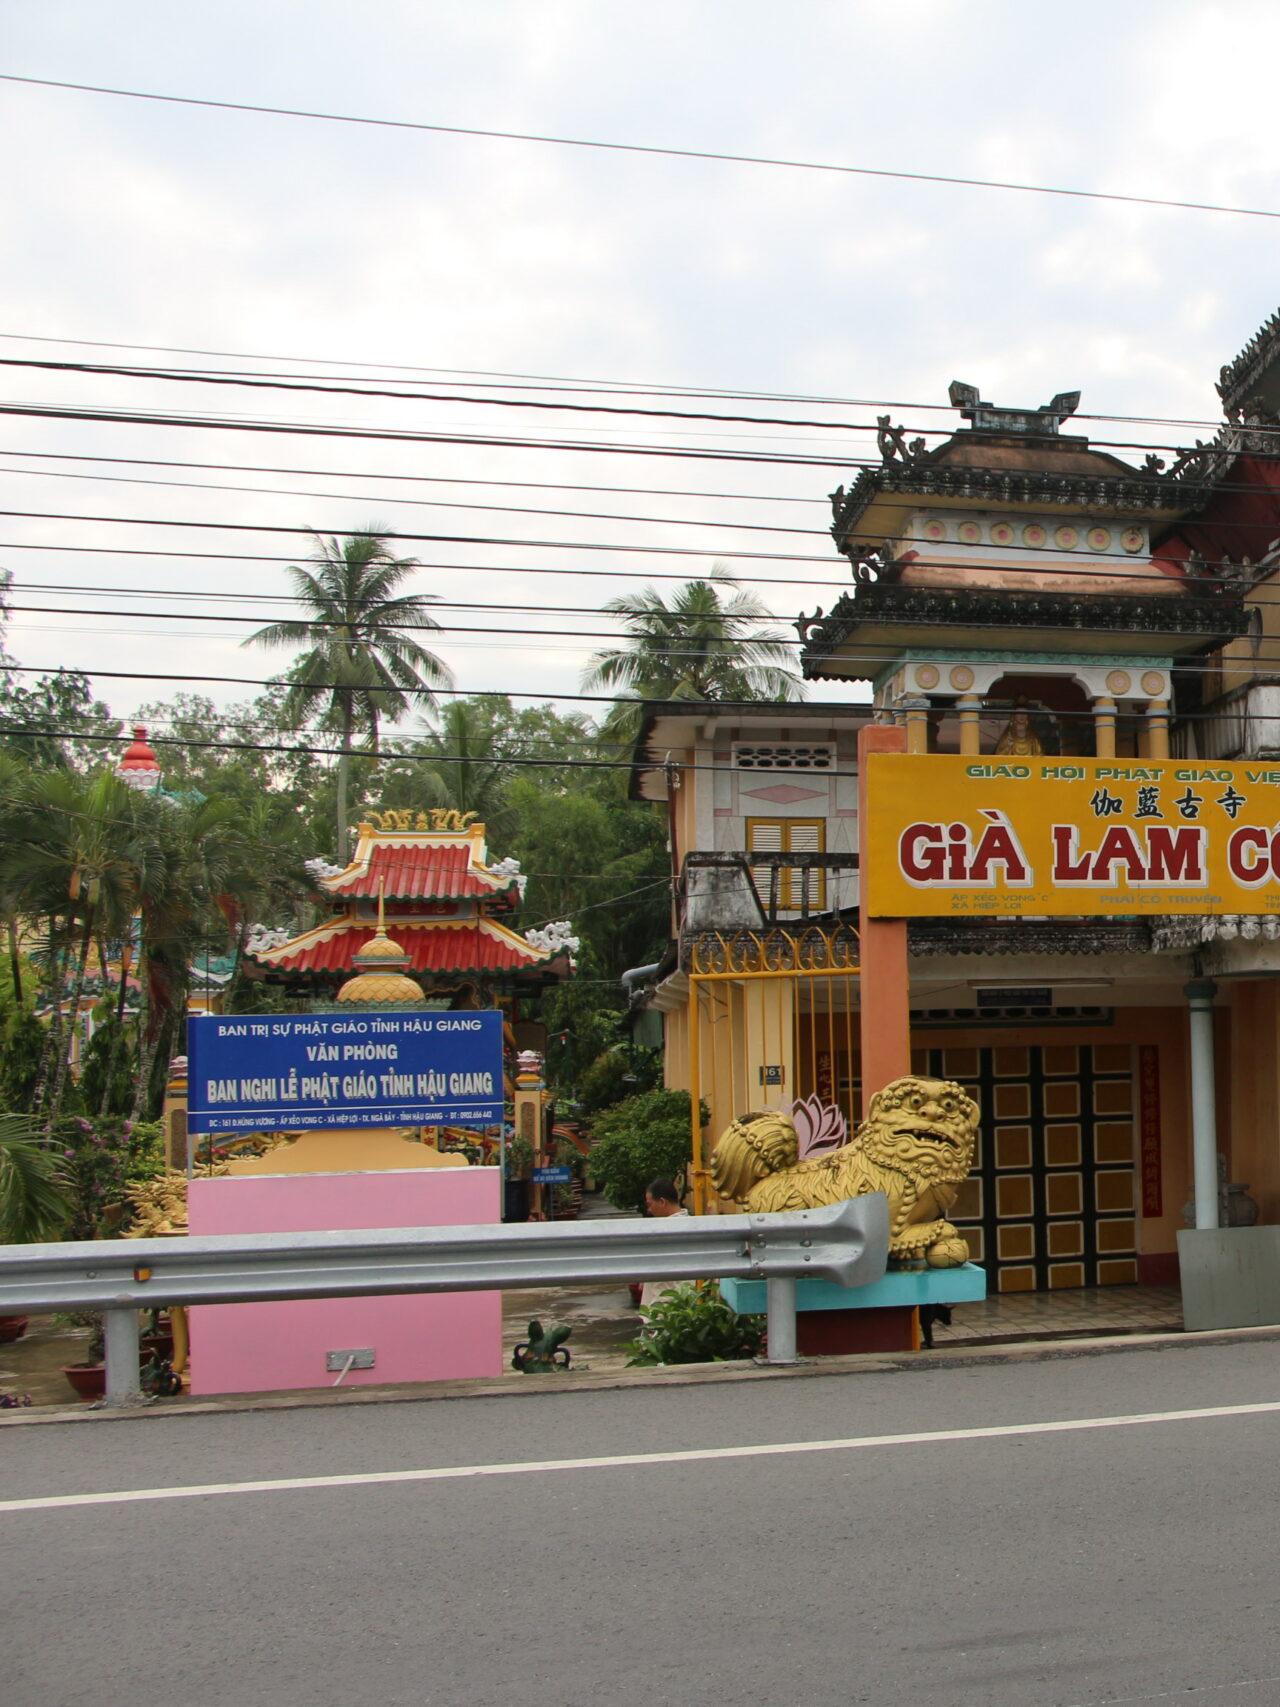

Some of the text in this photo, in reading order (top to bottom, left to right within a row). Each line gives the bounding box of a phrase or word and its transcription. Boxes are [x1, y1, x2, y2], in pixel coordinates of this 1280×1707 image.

[1051, 823, 1209, 889] LAM
[218, 1017, 482, 1037] BAN TRỊ SỰ PHẬT GIÁO TỈNH HẬU GIANG
[306, 1040, 398, 1062] VĂN PHÒNG
[207, 1066, 493, 1106] BAN NGHI LỄ PHẬT GIÁO TỈNH HẬU GIANG
